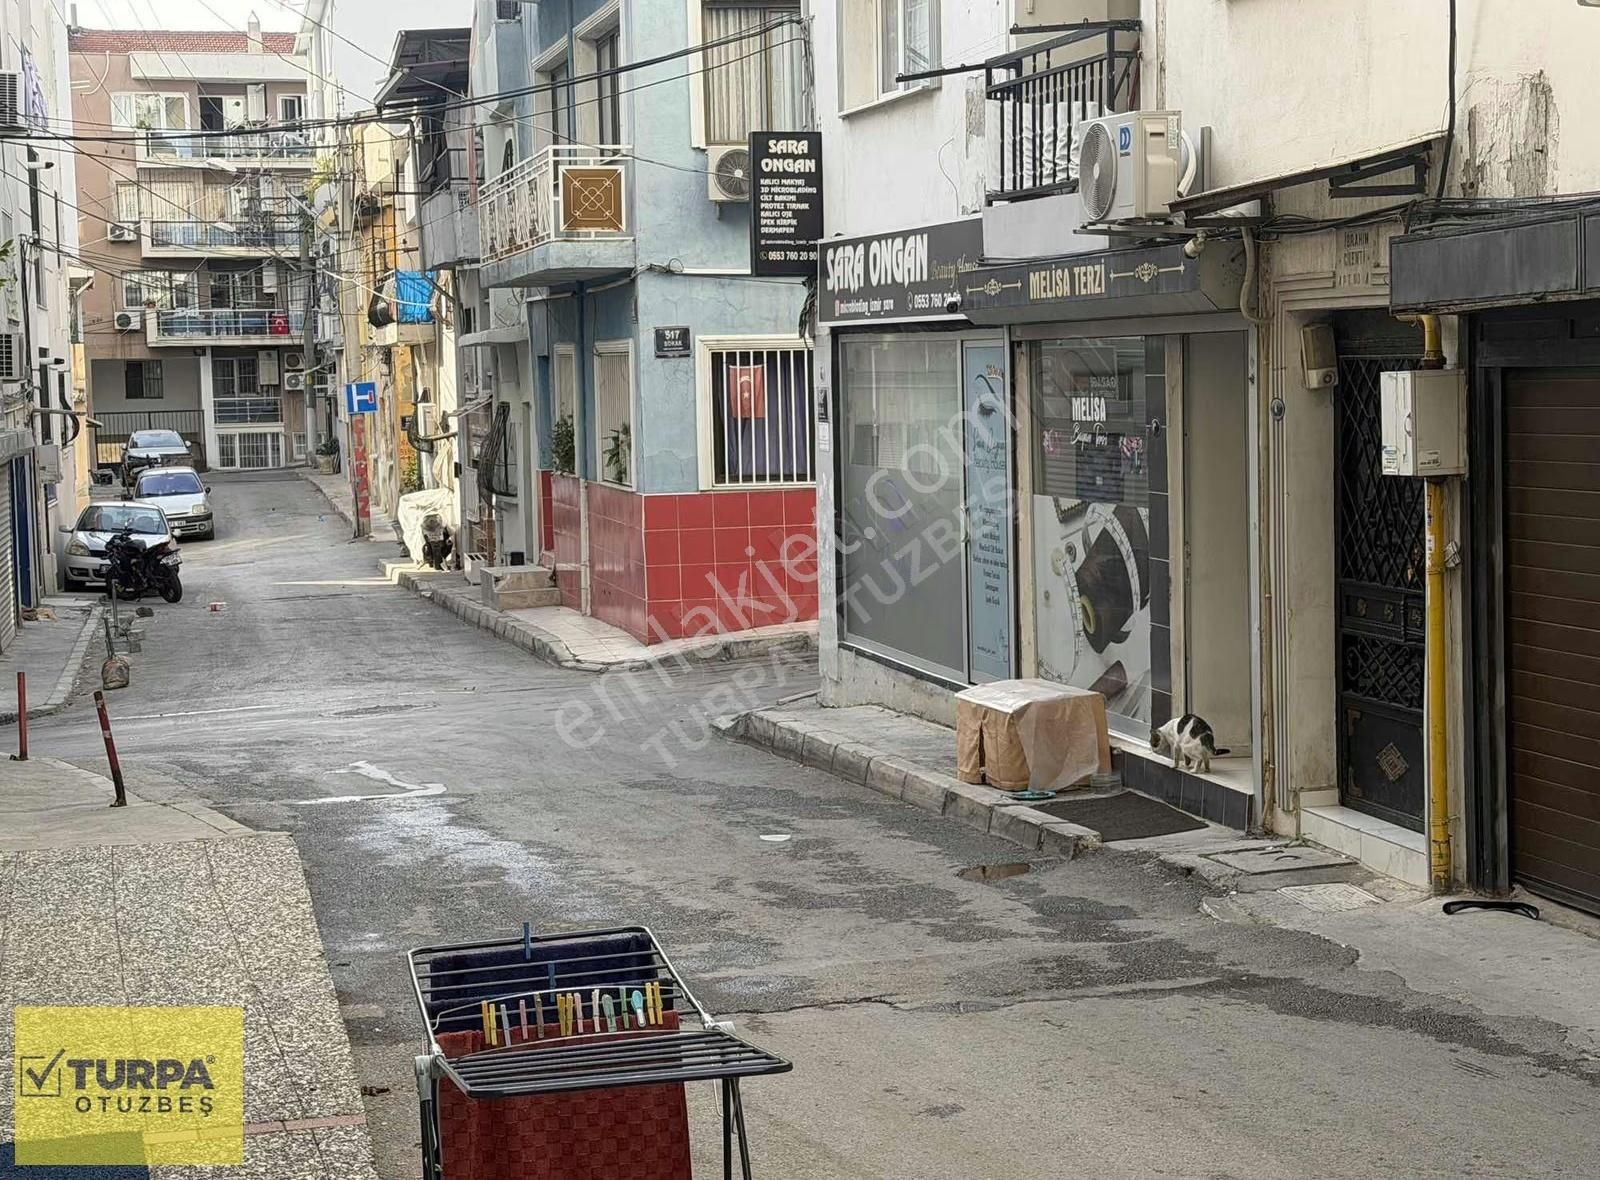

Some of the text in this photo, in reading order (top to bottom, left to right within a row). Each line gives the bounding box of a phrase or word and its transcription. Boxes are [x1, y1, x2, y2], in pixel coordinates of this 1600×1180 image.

[768, 140, 808, 154] SARA
[761, 159, 816, 173] ONGAN
[768, 251, 784, 260] 0553
[786, 251, 799, 260] 760
[800, 251, 808, 260] 20
[826, 233, 928, 295] SARA ONGAN
[1029, 259, 1106, 300] MELİSA TERZİ
[914, 292, 929, 309] 0553
[930, 292, 942, 308] 760
[1071, 392, 1107, 422] MELİSA
